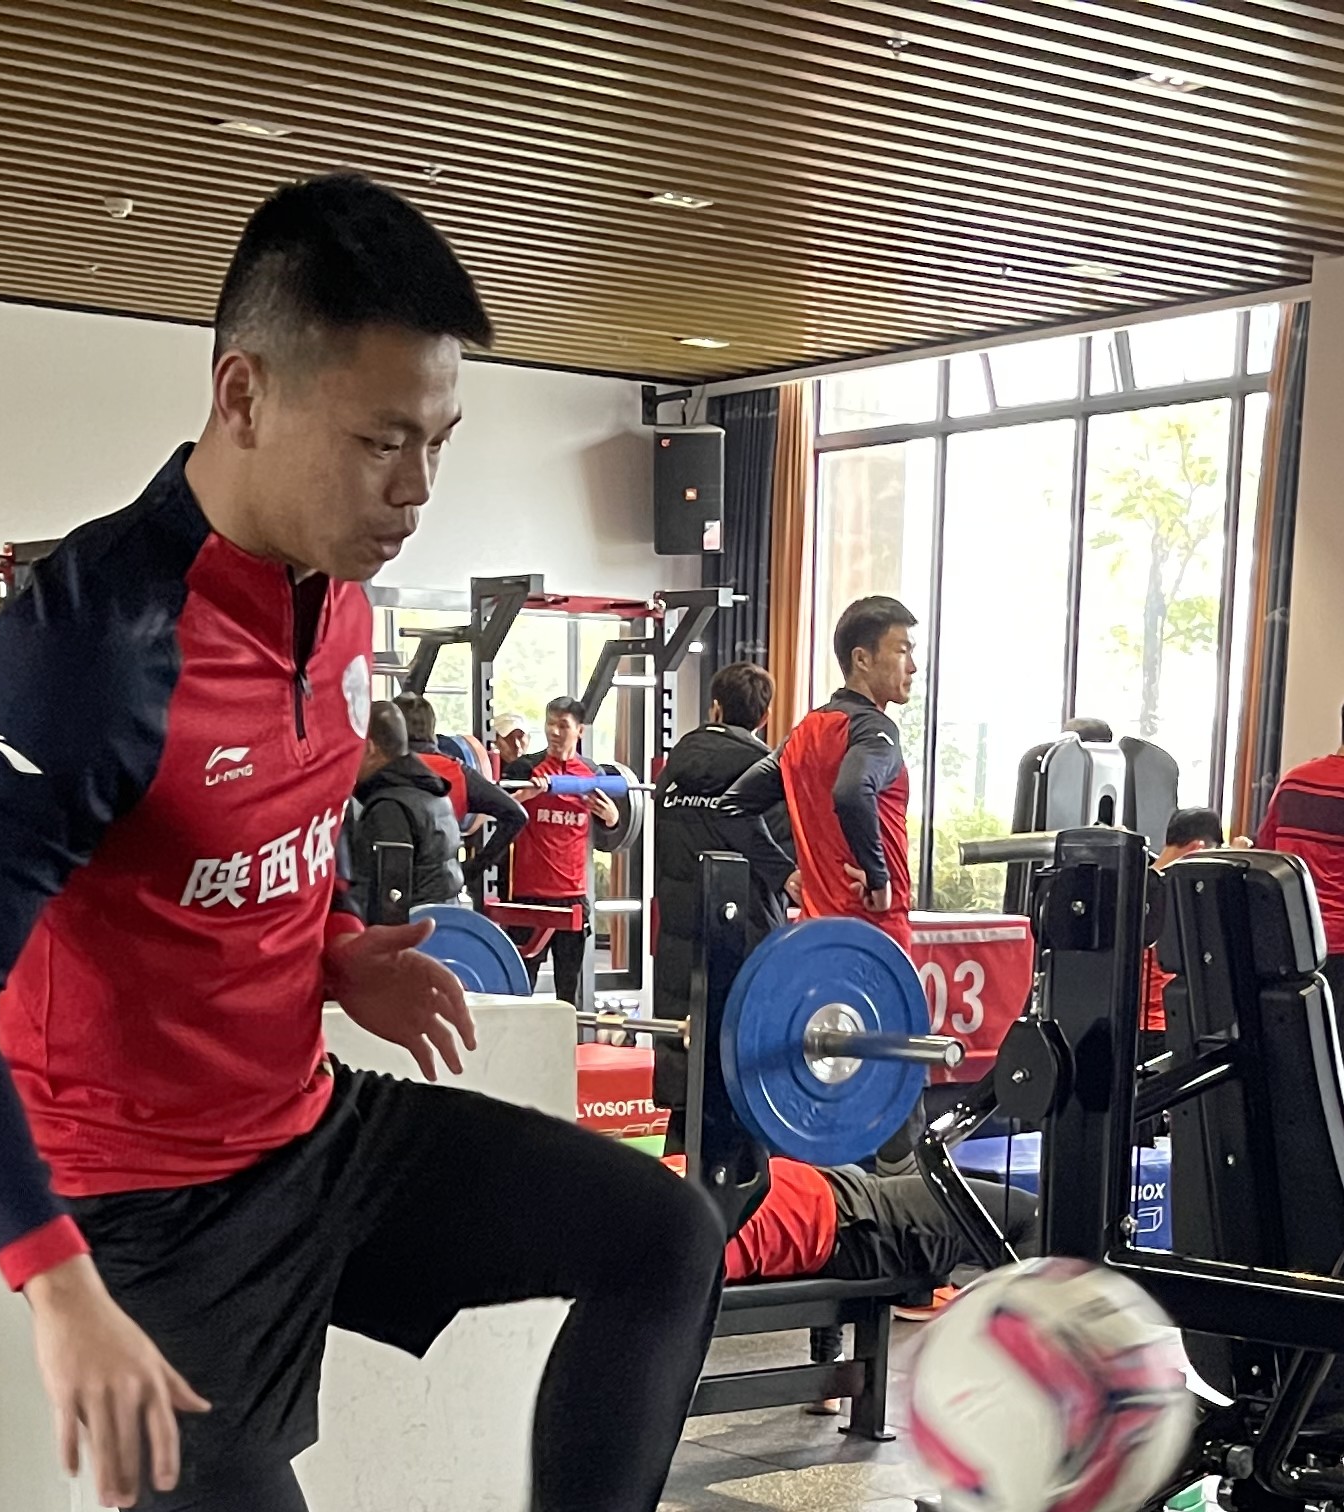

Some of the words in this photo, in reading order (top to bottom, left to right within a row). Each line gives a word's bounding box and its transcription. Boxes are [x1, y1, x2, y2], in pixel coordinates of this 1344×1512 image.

[179, 800, 349, 910] 陕西体
[575, 1099, 666, 1119] LYOSOFTB
